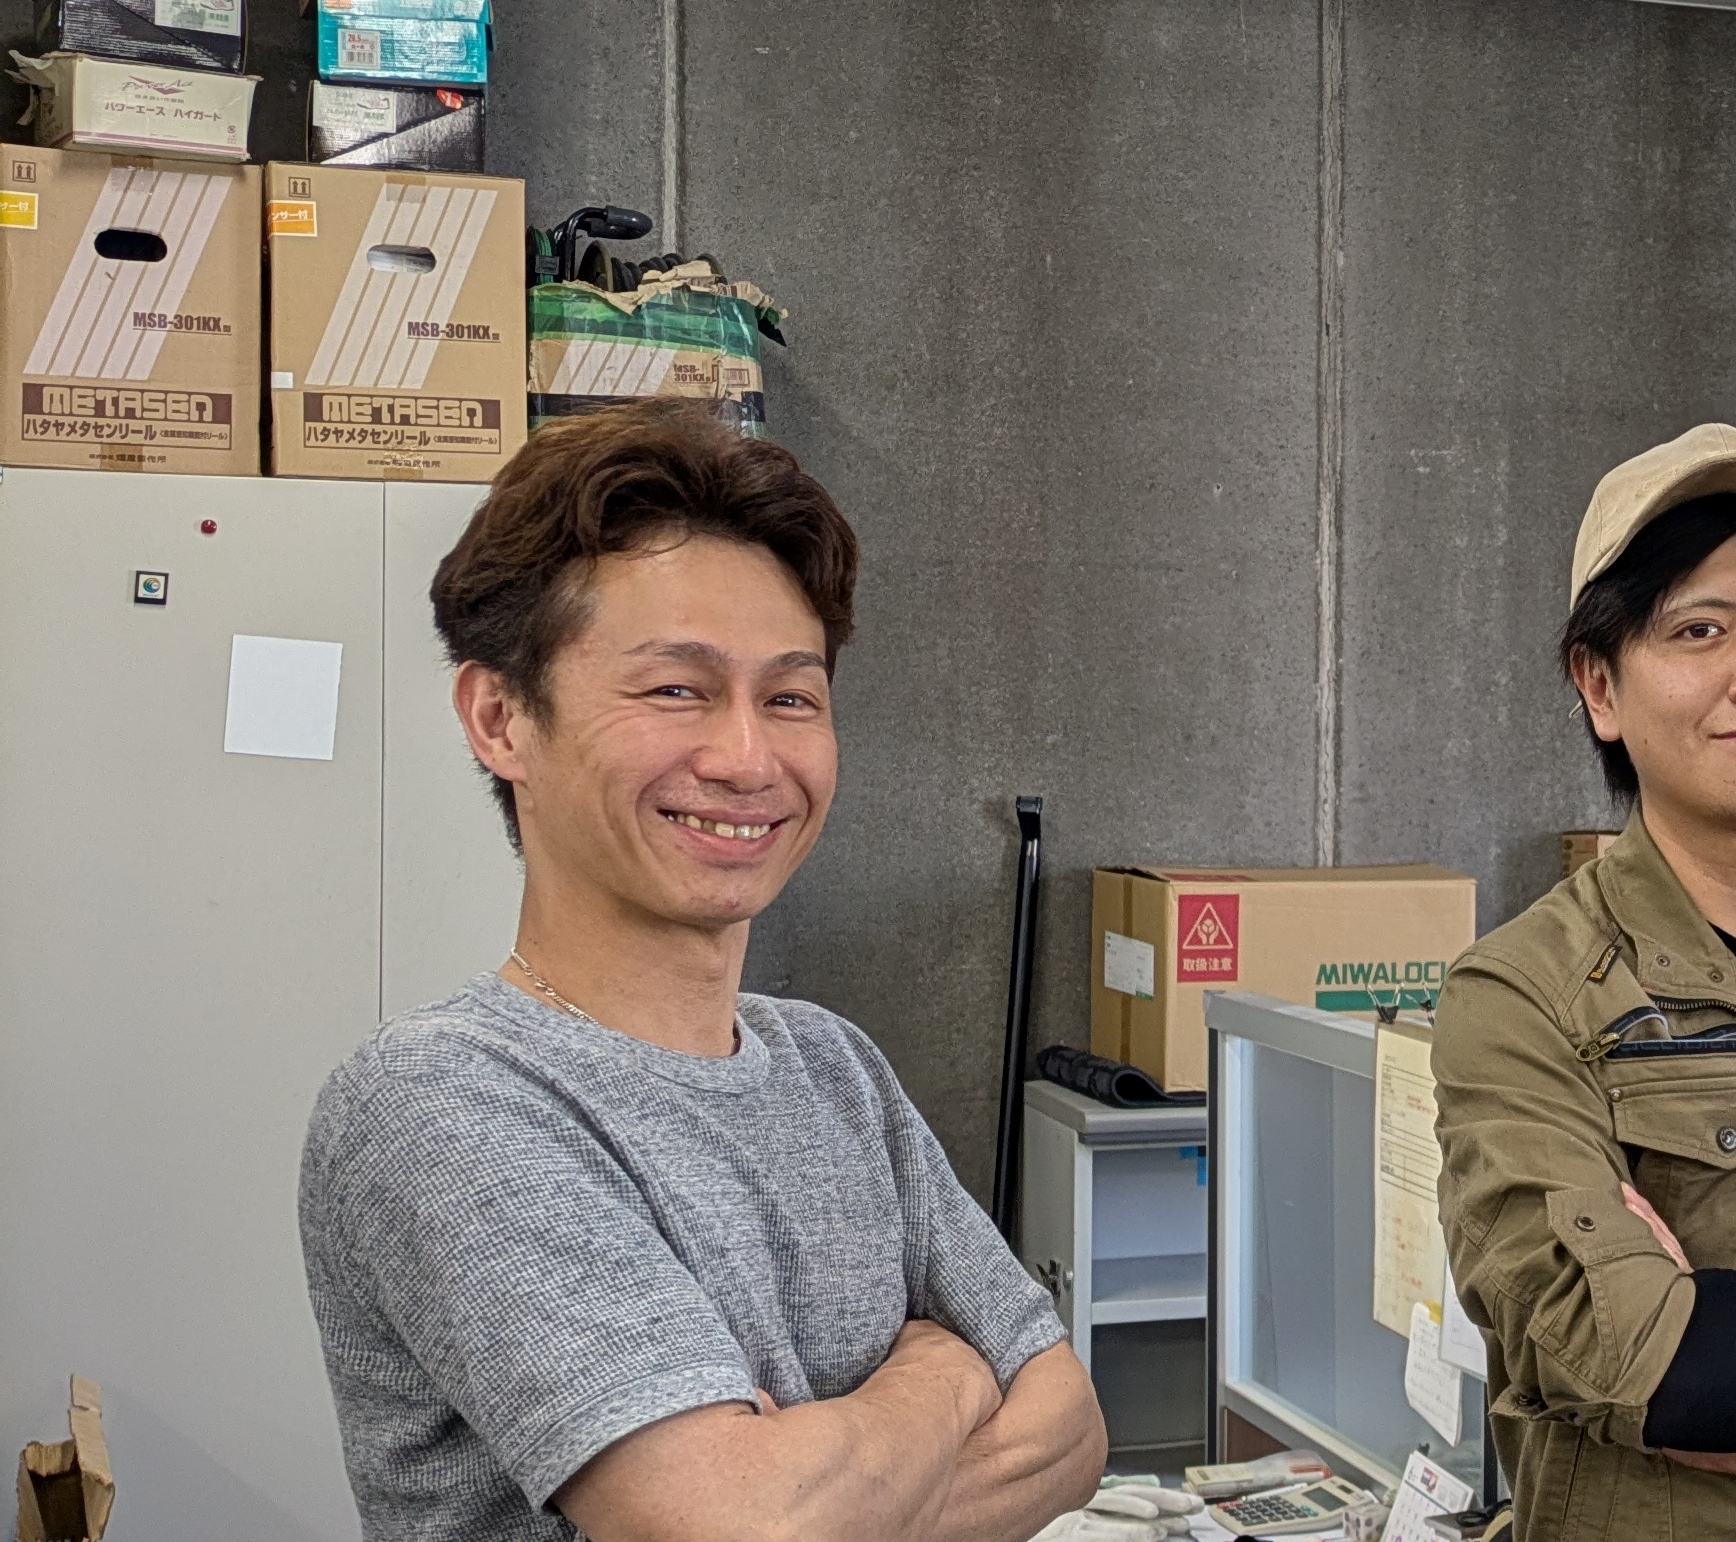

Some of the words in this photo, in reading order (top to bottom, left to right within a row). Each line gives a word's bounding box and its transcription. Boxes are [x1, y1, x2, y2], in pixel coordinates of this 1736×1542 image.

[105, 102, 165, 116] パワーエース
[174, 109, 222, 121] ハイガード
[133, 312, 221, 332] MSB-301KX
[407, 321, 490, 340] MSB-301KX
[42, 386, 213, 421] METASEN
[322, 394, 483, 427] METASEN
[25, 419, 156, 441] ハタヤメタセンリール
[307, 426, 431, 446] ハタヤメタセンリール
[1182, 957, 1233, 971] 取扱注意
